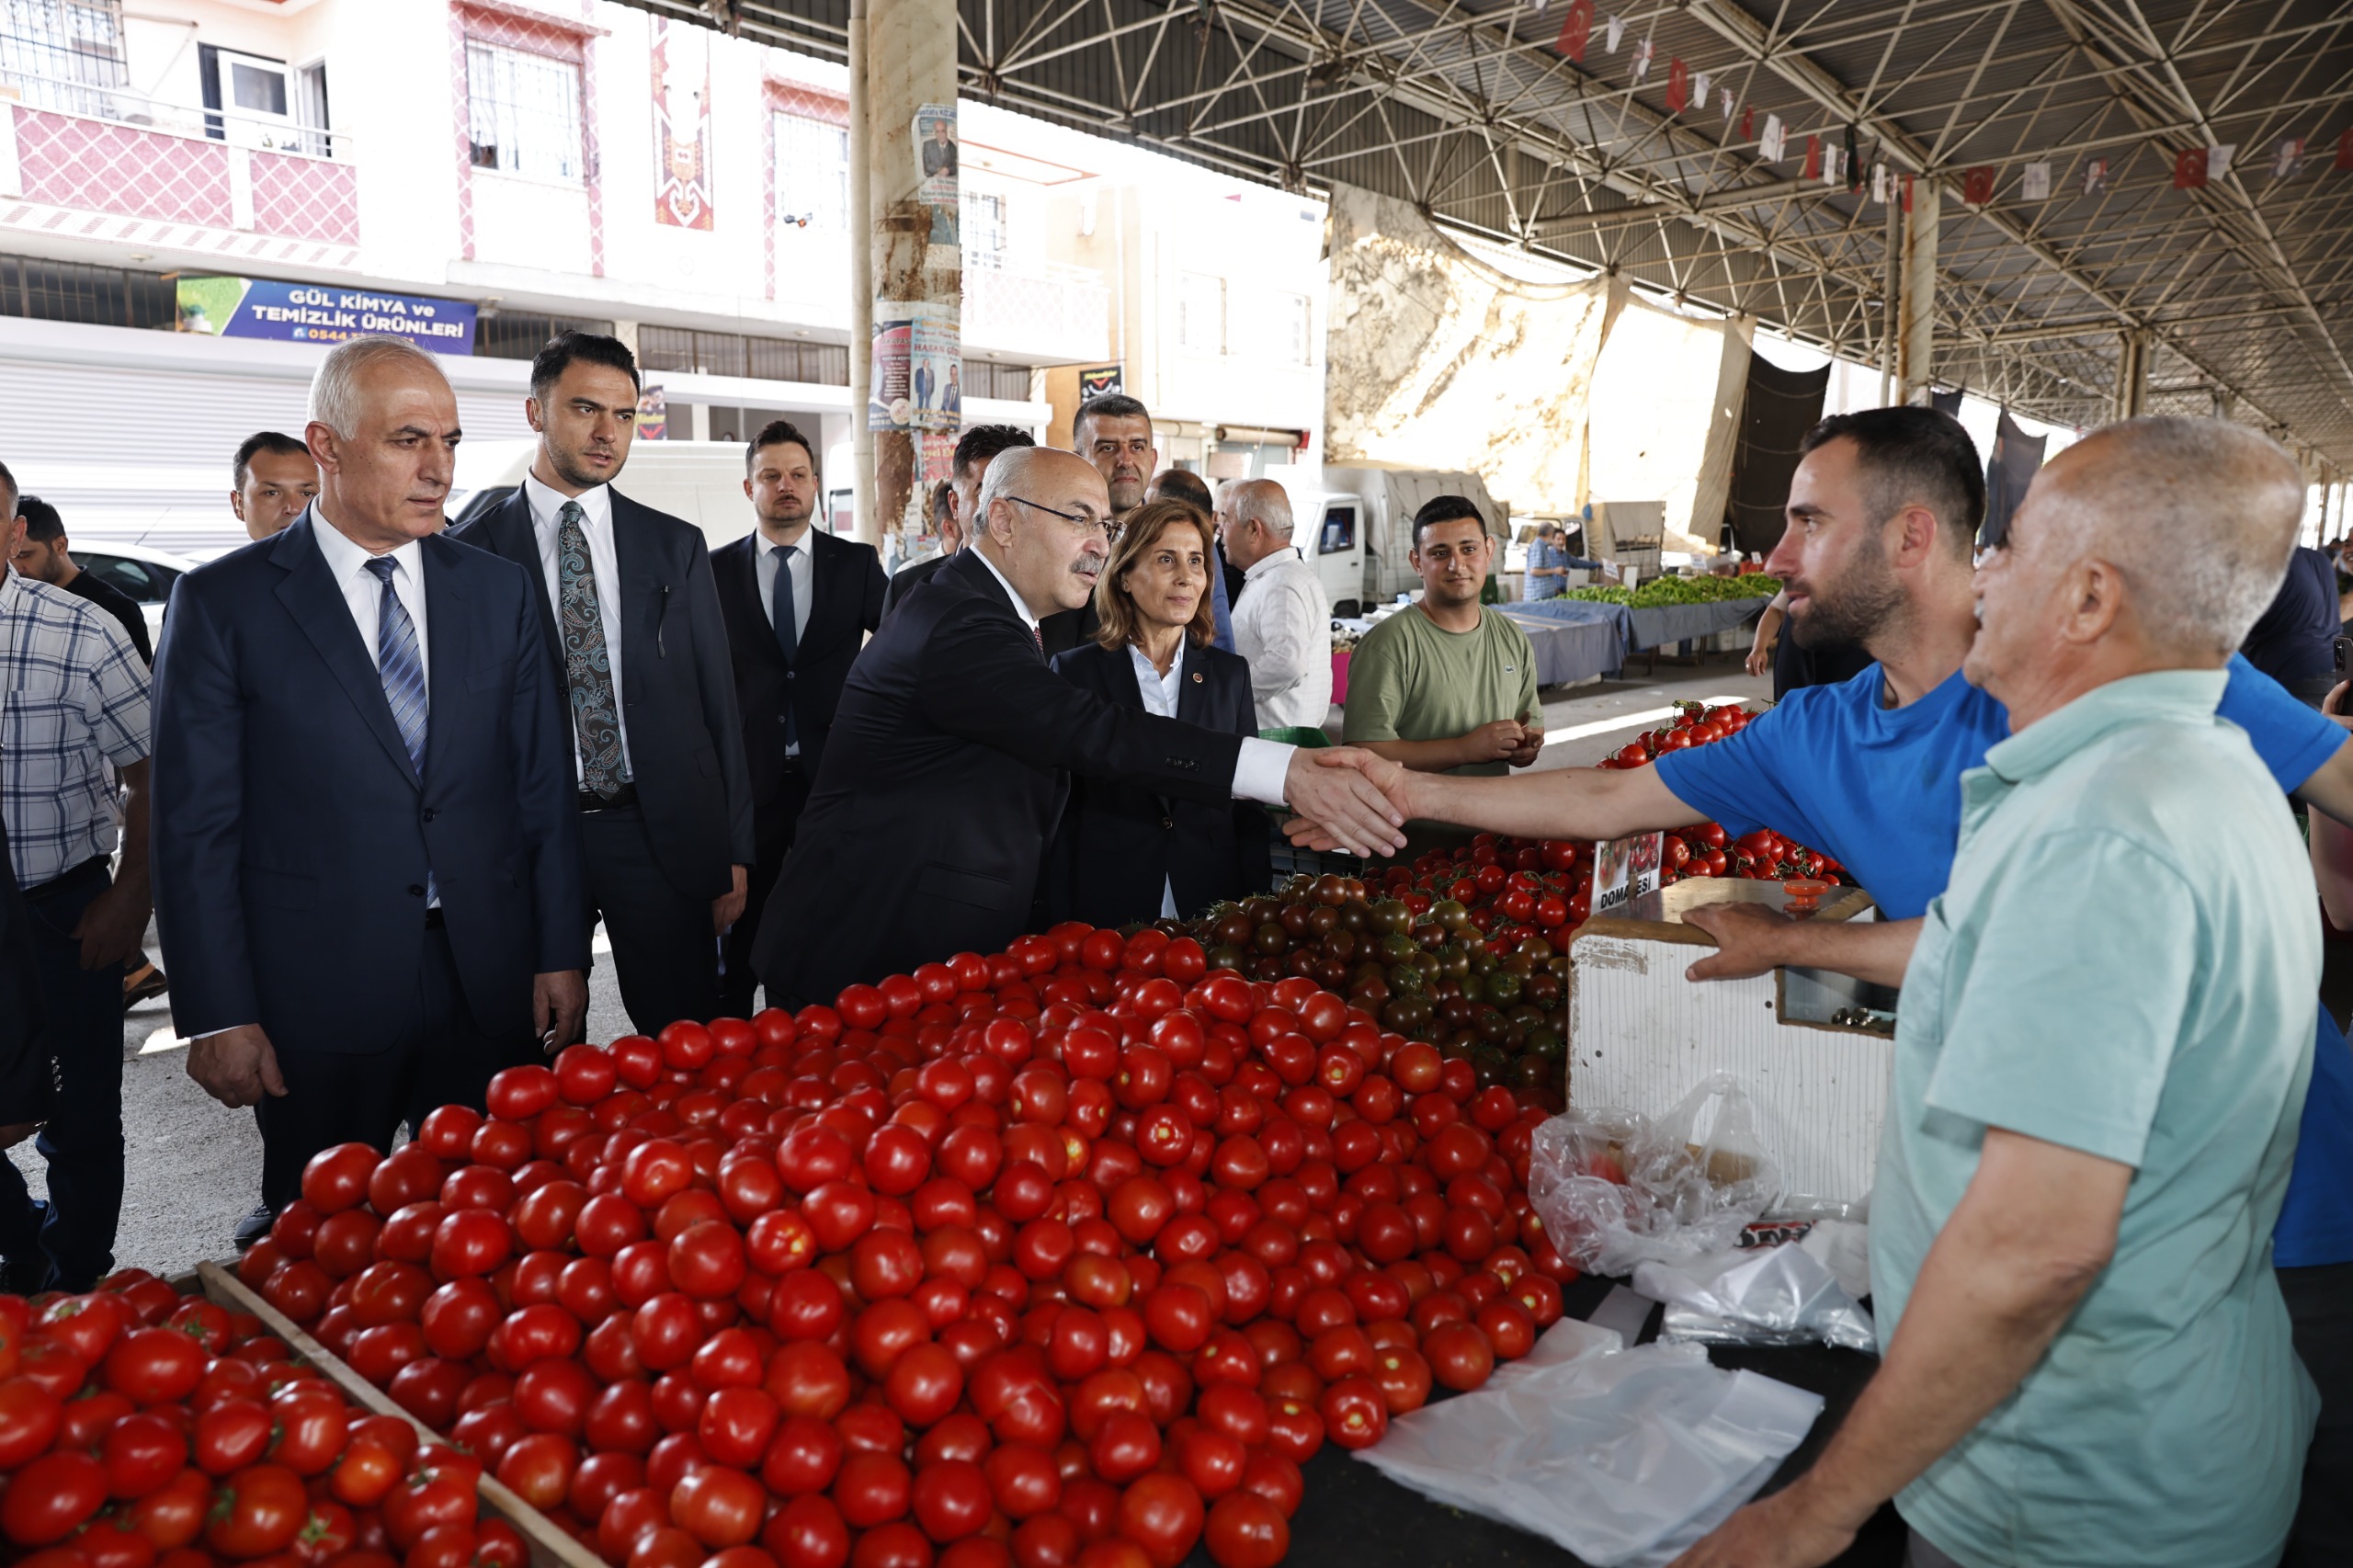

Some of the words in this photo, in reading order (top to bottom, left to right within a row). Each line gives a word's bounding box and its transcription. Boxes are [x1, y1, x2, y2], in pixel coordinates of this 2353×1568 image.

[289, 289, 335, 308] GÜL
[340, 293, 407, 315] KİMYA
[412, 304, 436, 318] ve
[252, 304, 357, 328] TEMİZLİK
[361, 312, 464, 338] ÜRÜNLERİ
[308, 328, 347, 340] 0544
[1600, 873, 1652, 909] DOMAESİ
